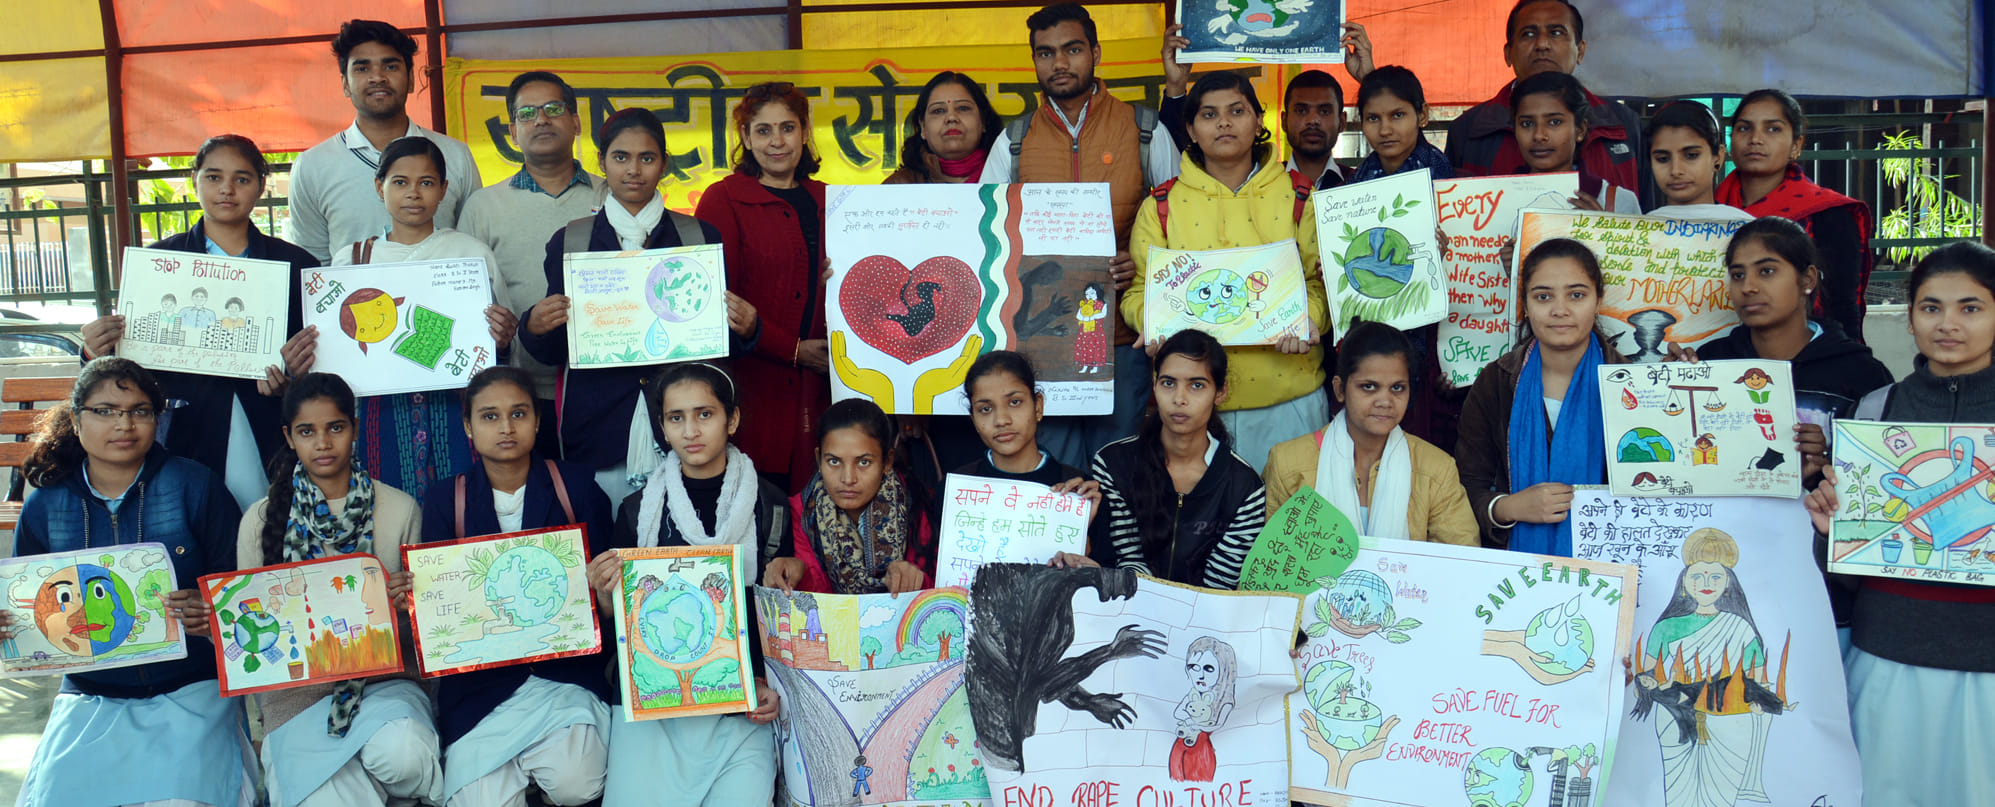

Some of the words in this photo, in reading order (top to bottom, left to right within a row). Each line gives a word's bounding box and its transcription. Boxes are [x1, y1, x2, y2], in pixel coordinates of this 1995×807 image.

[1301, 46, 1325, 54] EARTH
[1325, 195, 1349, 212] Save
[1437, 184, 1504, 231] Every
[1321, 211, 1345, 225] Save
[1572, 215, 1589, 229] We
[191, 259, 247, 282] Pollution
[1153, 264, 1171, 284] SAY
[1477, 271, 1510, 289] Siste
[1448, 288, 1475, 304] then
[1257, 315, 1278, 333] Save
[1280, 301, 1304, 321] Earth
[1460, 314, 1510, 334] daught
[1444, 336, 1491, 363] SAVE
[954, 483, 995, 506] सपने
[1578, 498, 1611, 517] अपने
[991, 517, 1013, 534] हम
[418, 554, 445, 569] SAVE
[1377, 557, 1408, 573] Save
[430, 570, 461, 584] WATER
[1880, 566, 1898, 579] SAY
[1902, 569, 1918, 582] NO
[1922, 568, 1958, 585] PLASTIC
[1965, 572, 1985, 586] BAG
[420, 590, 445, 603] SAVE
[1475, 565, 1538, 626] SAVE
[1541, 562, 1624, 606] EARTH
[436, 602, 462, 618] LIFE
[653, 648, 677, 662] DROP
[1432, 687, 1480, 714] SAVE
[1482, 689, 1523, 719] FUEL
[1525, 698, 1561, 729] FOR
[1412, 718, 1478, 747] BETTER
[1003, 783, 1055, 807] END
[1136, 779, 1254, 807] CULTURE
